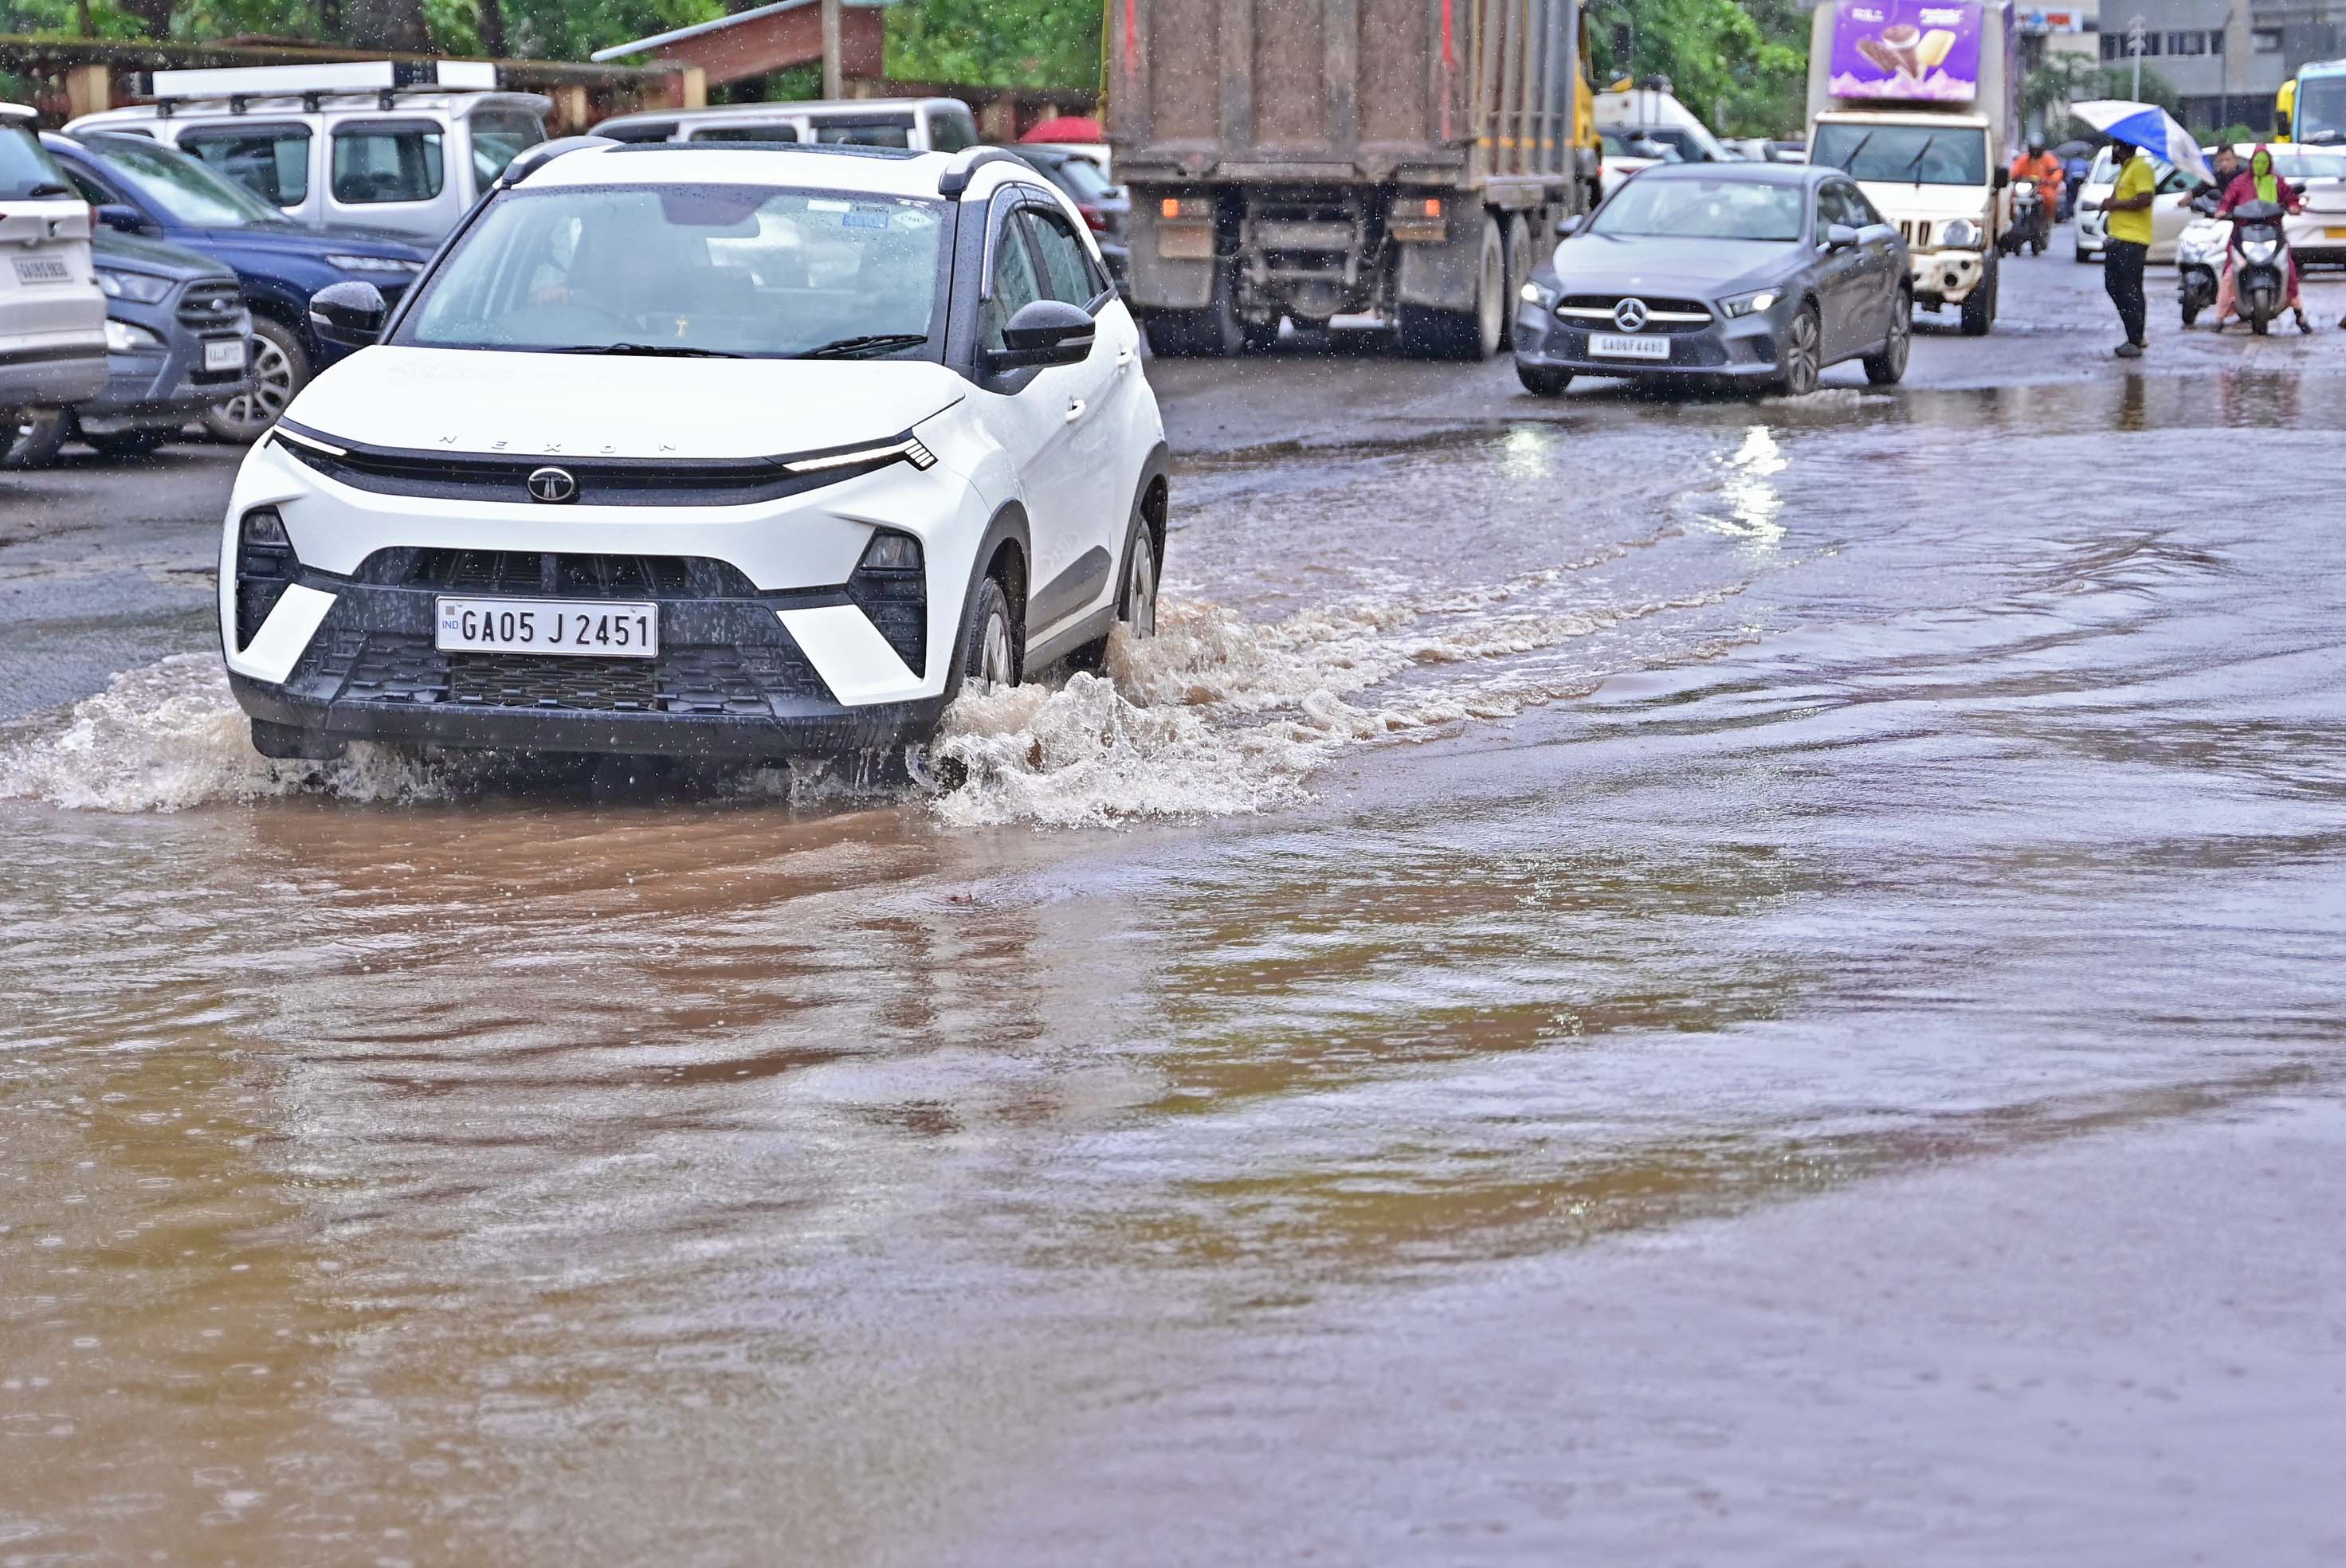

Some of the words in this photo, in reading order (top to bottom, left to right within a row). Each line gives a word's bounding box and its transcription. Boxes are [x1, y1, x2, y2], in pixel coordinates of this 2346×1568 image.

[439, 436, 676, 453] NEXON
[441, 620, 459, 630] IND
[461, 610, 535, 642] GA05
[547, 613, 563, 644] J
[575, 613, 648, 647] 2451
